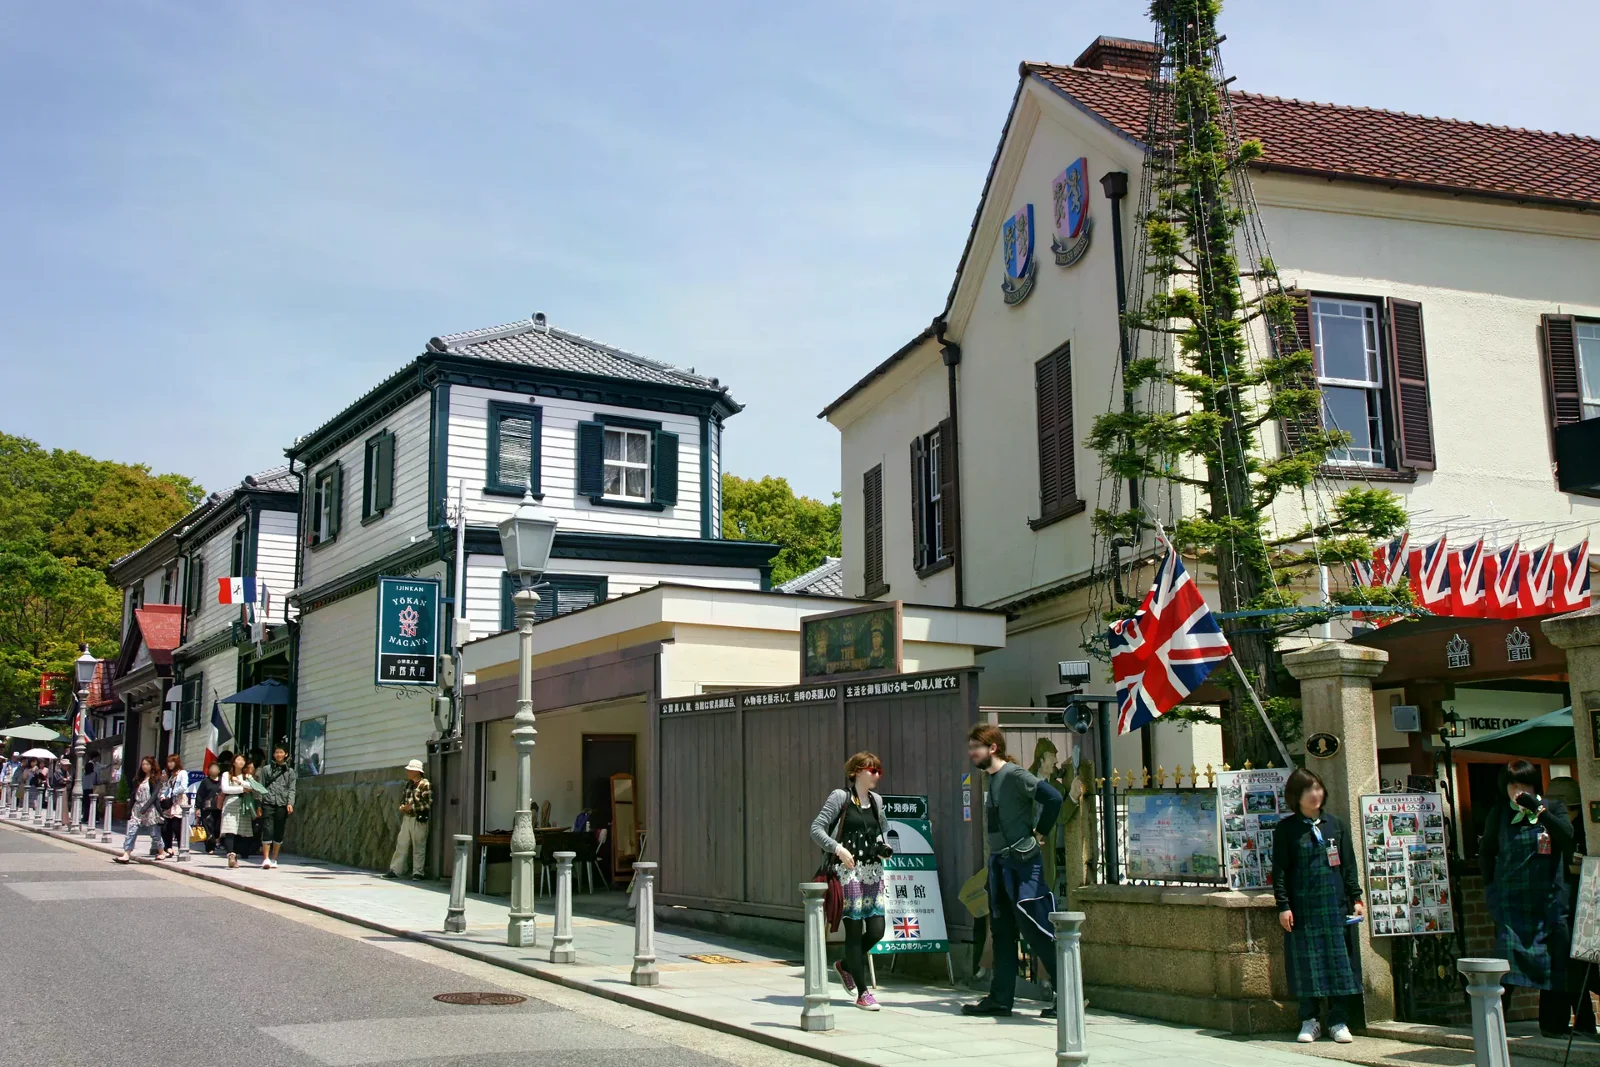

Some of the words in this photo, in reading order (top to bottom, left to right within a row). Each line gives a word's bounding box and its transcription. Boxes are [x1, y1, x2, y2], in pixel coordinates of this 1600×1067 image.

[388, 635, 428, 647] NAGAYA
[1508, 647, 1531, 661] EH
[1448, 655, 1470, 668] EH
[1469, 717, 1501, 730] TICKET
[884, 942, 933, 951] うろこの家グループ
